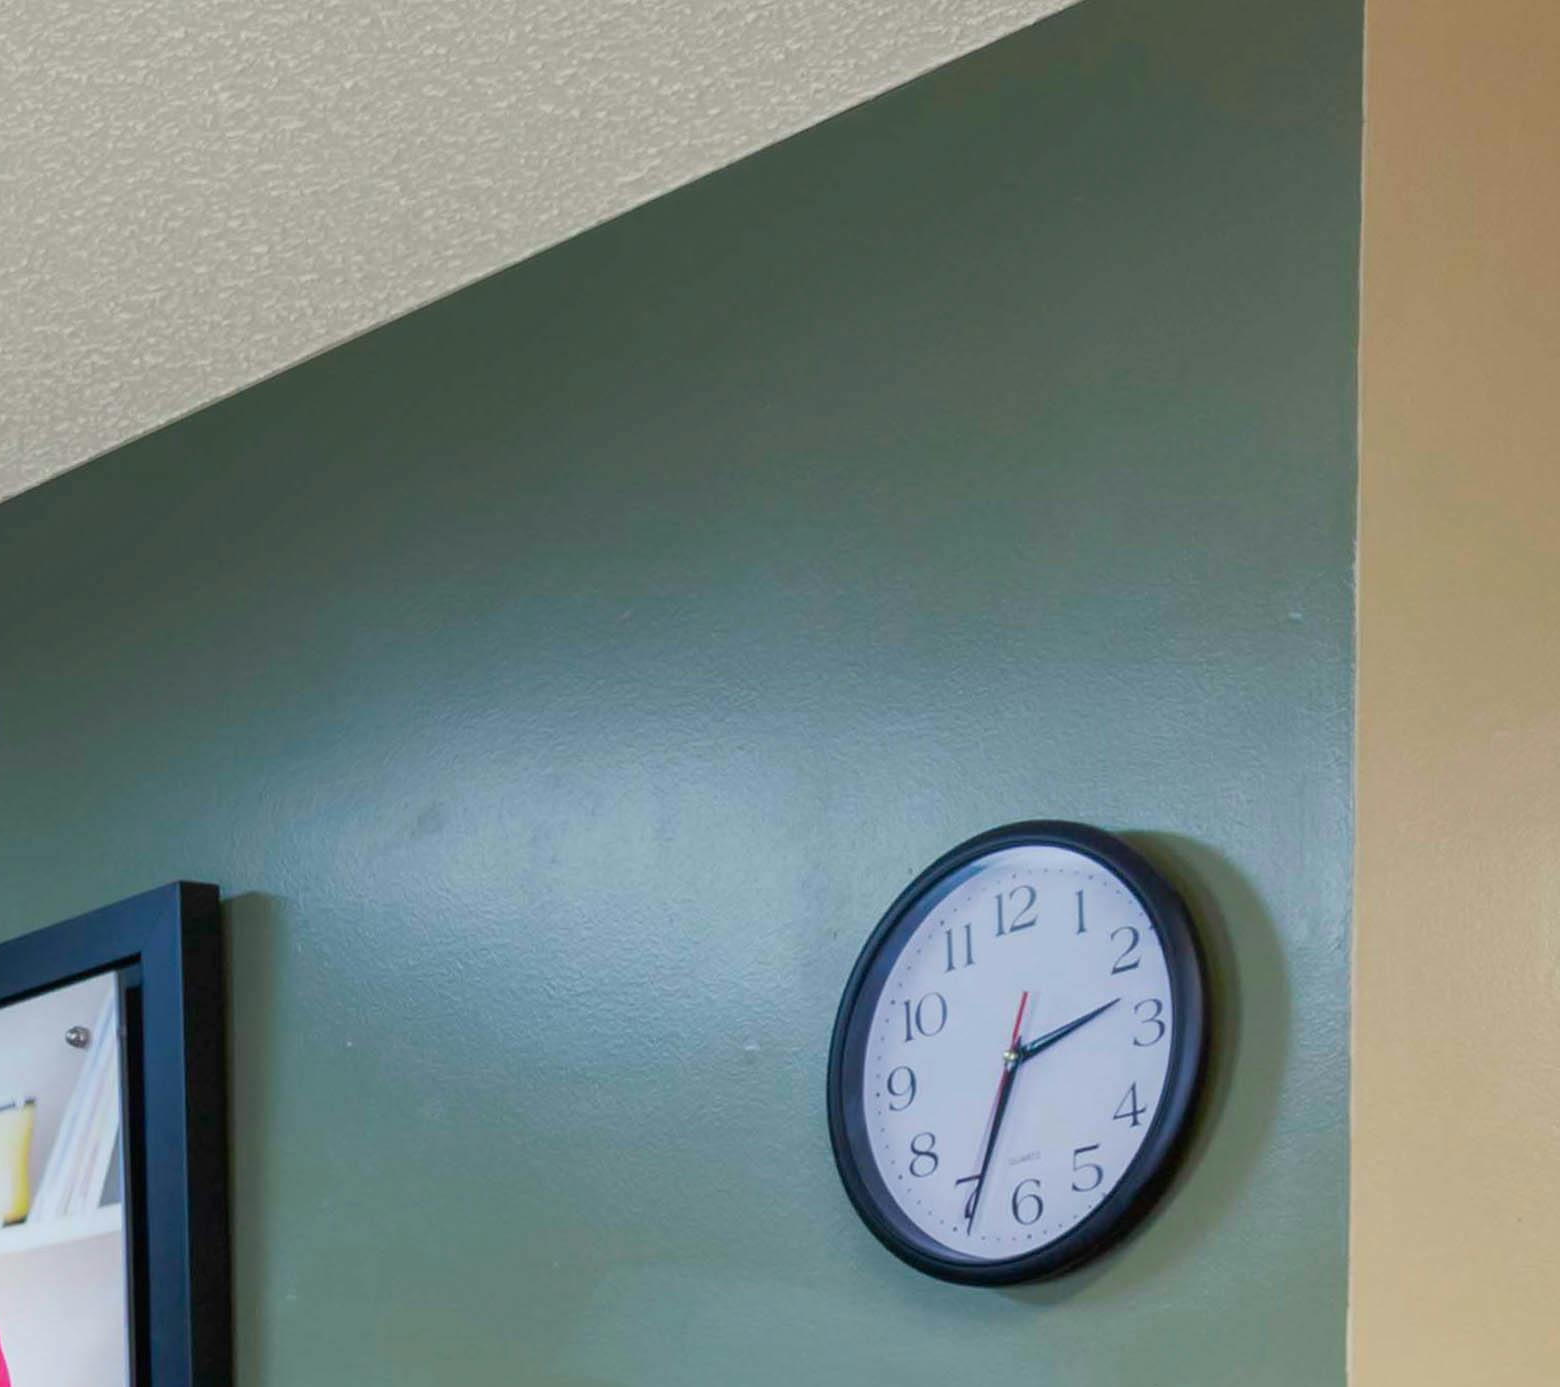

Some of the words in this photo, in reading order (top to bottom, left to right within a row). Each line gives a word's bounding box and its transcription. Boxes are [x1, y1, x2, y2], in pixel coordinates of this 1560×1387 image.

[994, 885, 1038, 937] 12
[1074, 890, 1088, 934] 1
[944, 923, 975, 972] 11
[1110, 926, 1141, 975] 2
[903, 991, 948, 1042] 10
[1133, 998, 1166, 1047] 3
[886, 1066, 917, 1111] 9
[1112, 1082, 1147, 1127] 4
[909, 1132, 939, 1177] 8
[1071, 1144, 1104, 1192] 5
[1011, 1179, 1044, 1225] 6
